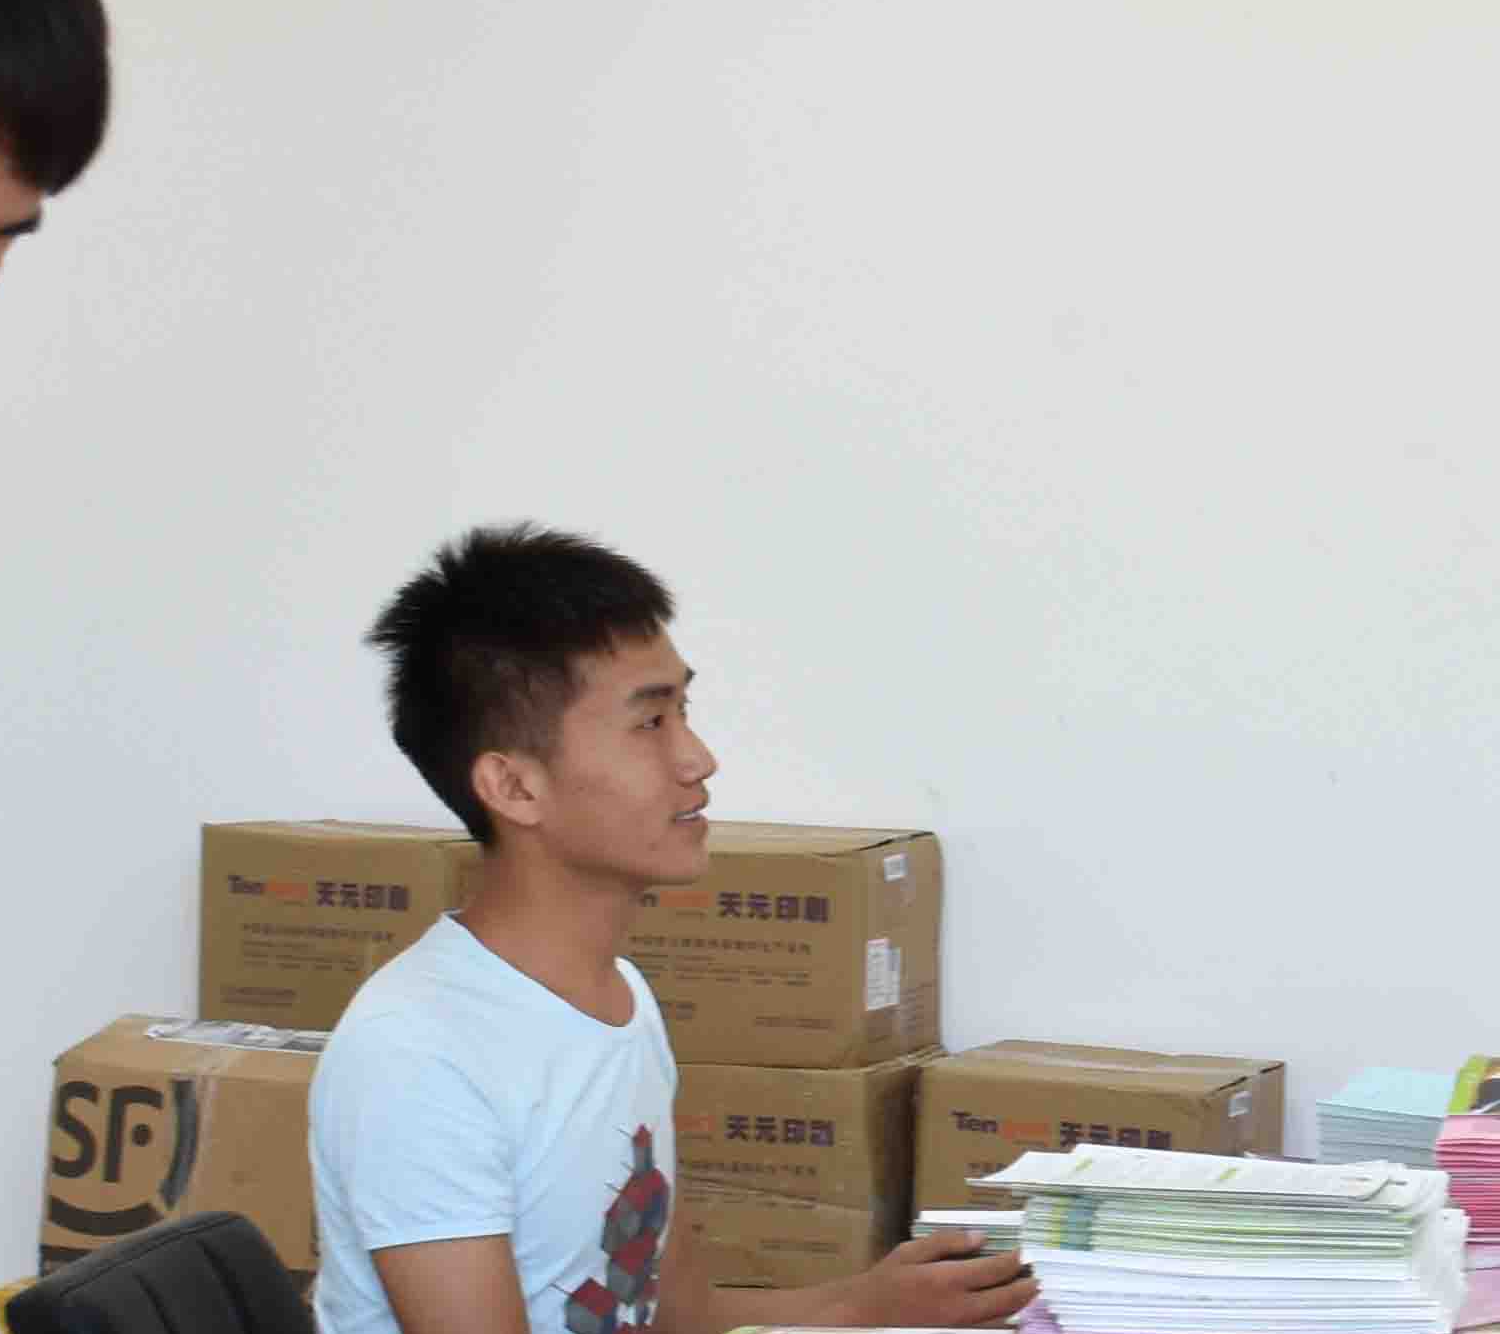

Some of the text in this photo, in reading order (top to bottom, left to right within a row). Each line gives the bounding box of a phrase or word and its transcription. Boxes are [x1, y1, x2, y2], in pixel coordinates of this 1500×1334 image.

[316, 881, 411, 912] 天元印刷
[718, 892, 831, 923] 天元印刷
[51, 1080, 165, 1184] SF
[725, 1115, 837, 1148] 天元印刷
